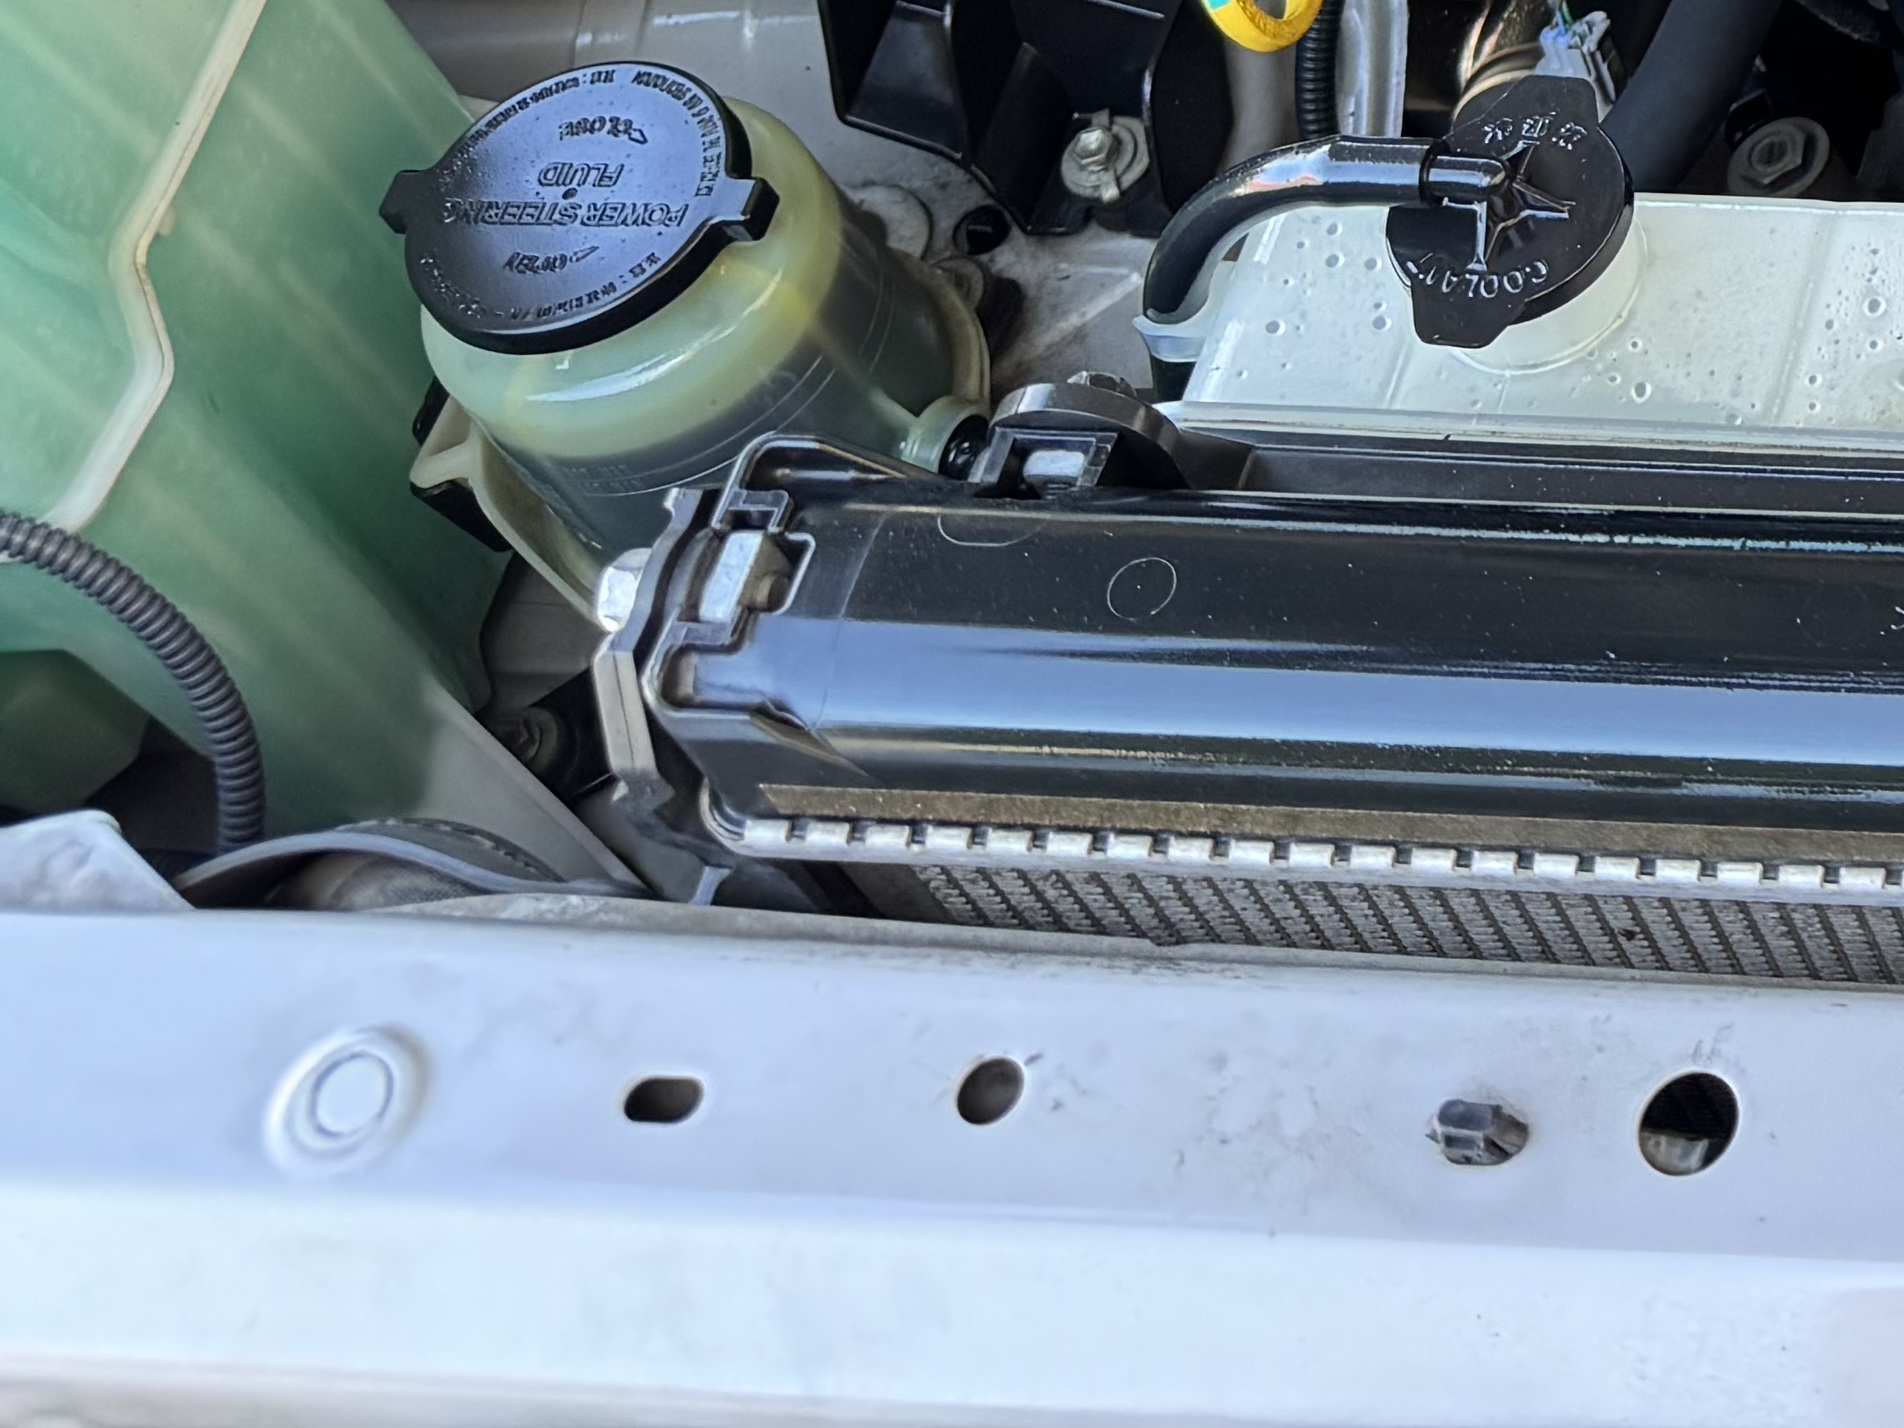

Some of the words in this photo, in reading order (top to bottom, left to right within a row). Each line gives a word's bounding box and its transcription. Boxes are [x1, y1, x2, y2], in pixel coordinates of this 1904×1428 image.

[536, 161, 626, 189] FLUID
[442, 196, 582, 227] STEERING
[582, 201, 690, 228] POWER
